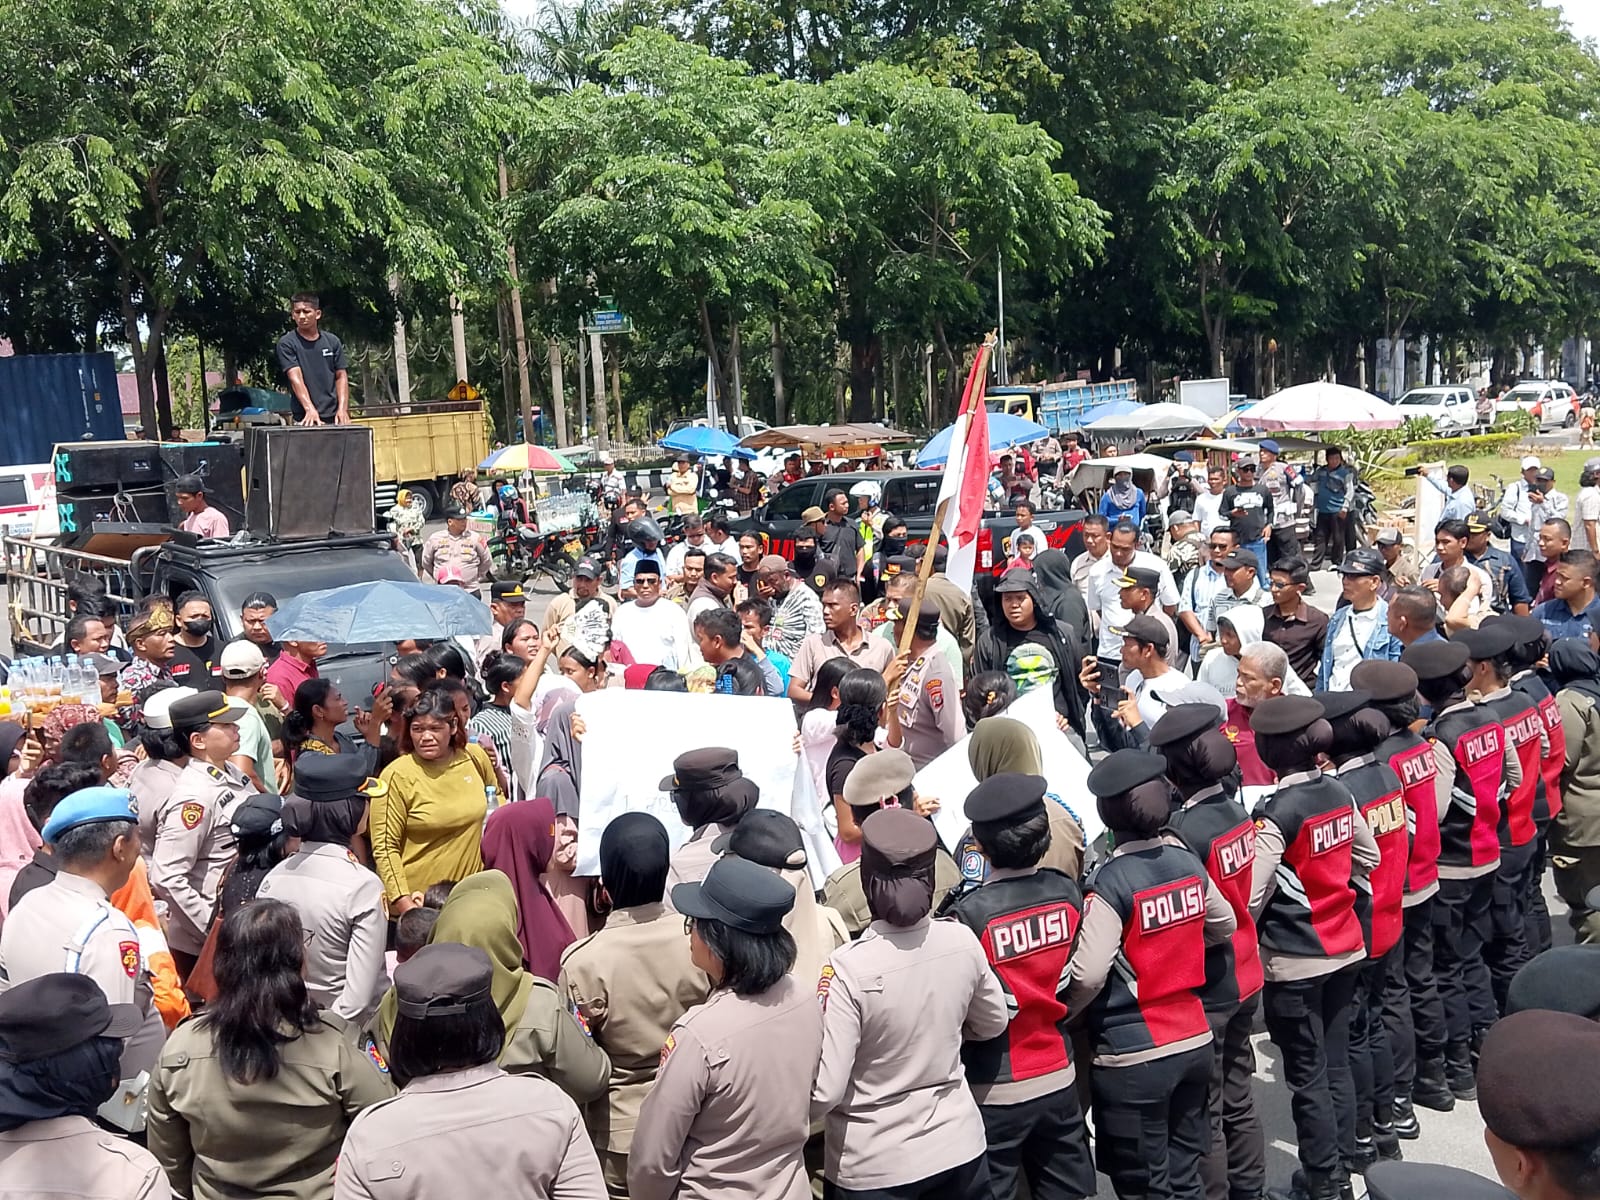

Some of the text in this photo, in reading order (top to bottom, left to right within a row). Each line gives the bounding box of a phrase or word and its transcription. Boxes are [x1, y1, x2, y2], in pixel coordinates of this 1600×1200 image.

[1505, 712, 1540, 747] POLIS
[1546, 703, 1561, 728] POL
[1466, 730, 1499, 763] POLISI
[1402, 751, 1435, 785] POLIS
[1313, 813, 1353, 853] POLISI
[1367, 796, 1405, 836] POLIS
[1220, 829, 1255, 874] POLIS
[1141, 885, 1204, 929] POLISI
[993, 910, 1070, 958] POLISI
